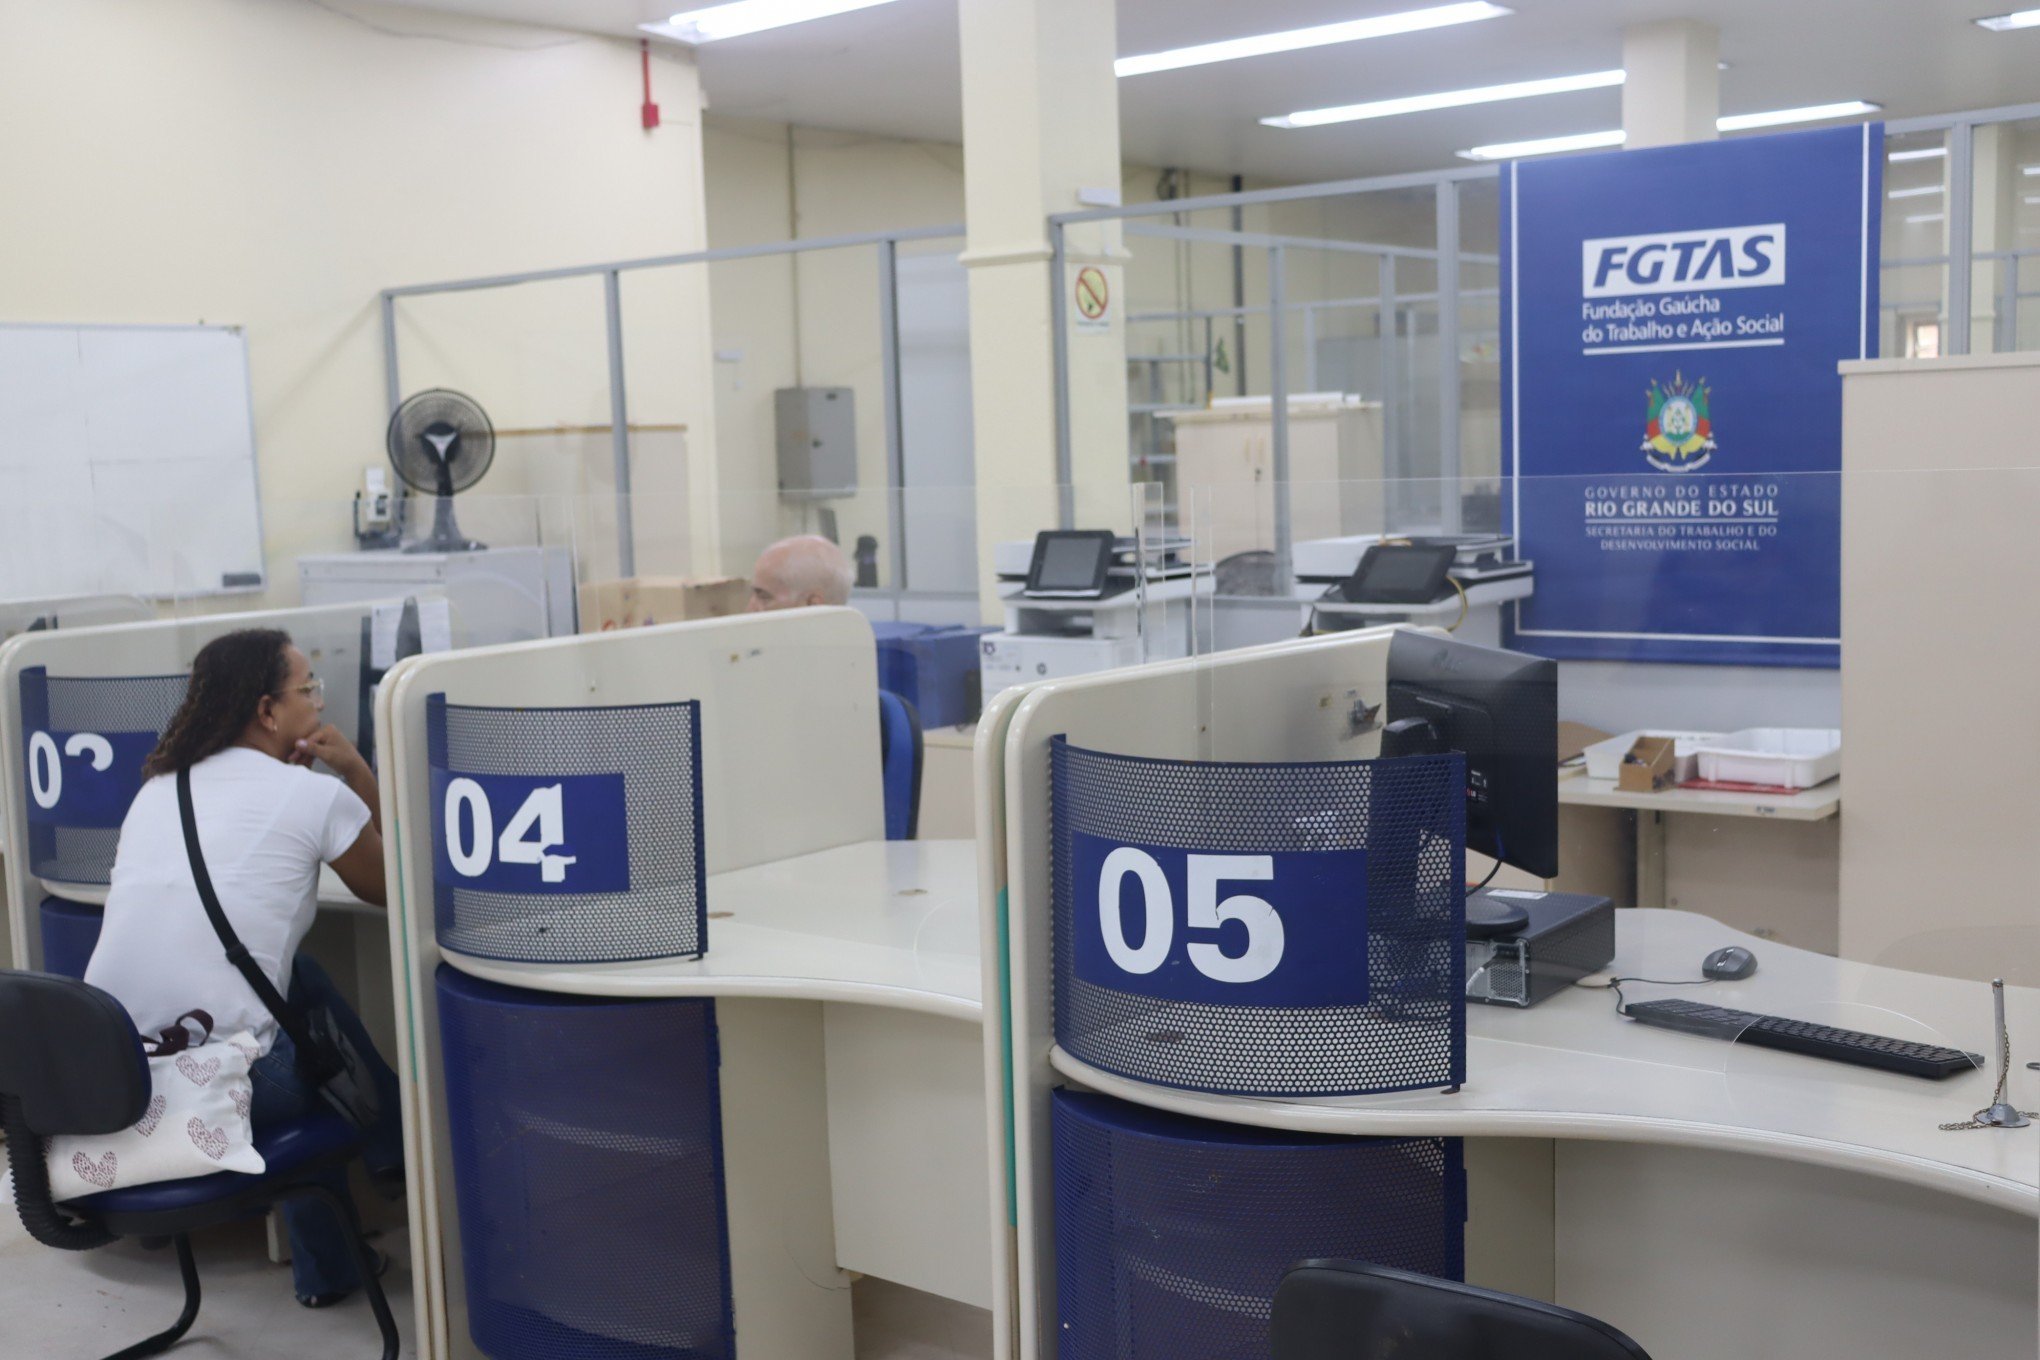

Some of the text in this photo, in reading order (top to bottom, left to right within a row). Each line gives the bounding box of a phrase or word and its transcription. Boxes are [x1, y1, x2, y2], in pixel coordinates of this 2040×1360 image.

[1593, 234, 1774, 288] FGTAS
[1582, 294, 1720, 324] Fundação Gaúcha
[1582, 312, 1784, 343] do Trabalho e Ação Social
[1584, 484, 1778, 499] GOVERNO DO ESTADO
[1585, 499, 1779, 517] RIO GRANDE DO SUL
[1585, 525, 1777, 537] SECRETARIA DO TRABALHO E DO
[1600, 539, 1760, 551] DESENVOLVIMENTO SOCIAL
[444, 777, 577, 883] 04
[1098, 846, 1285, 984] 05
